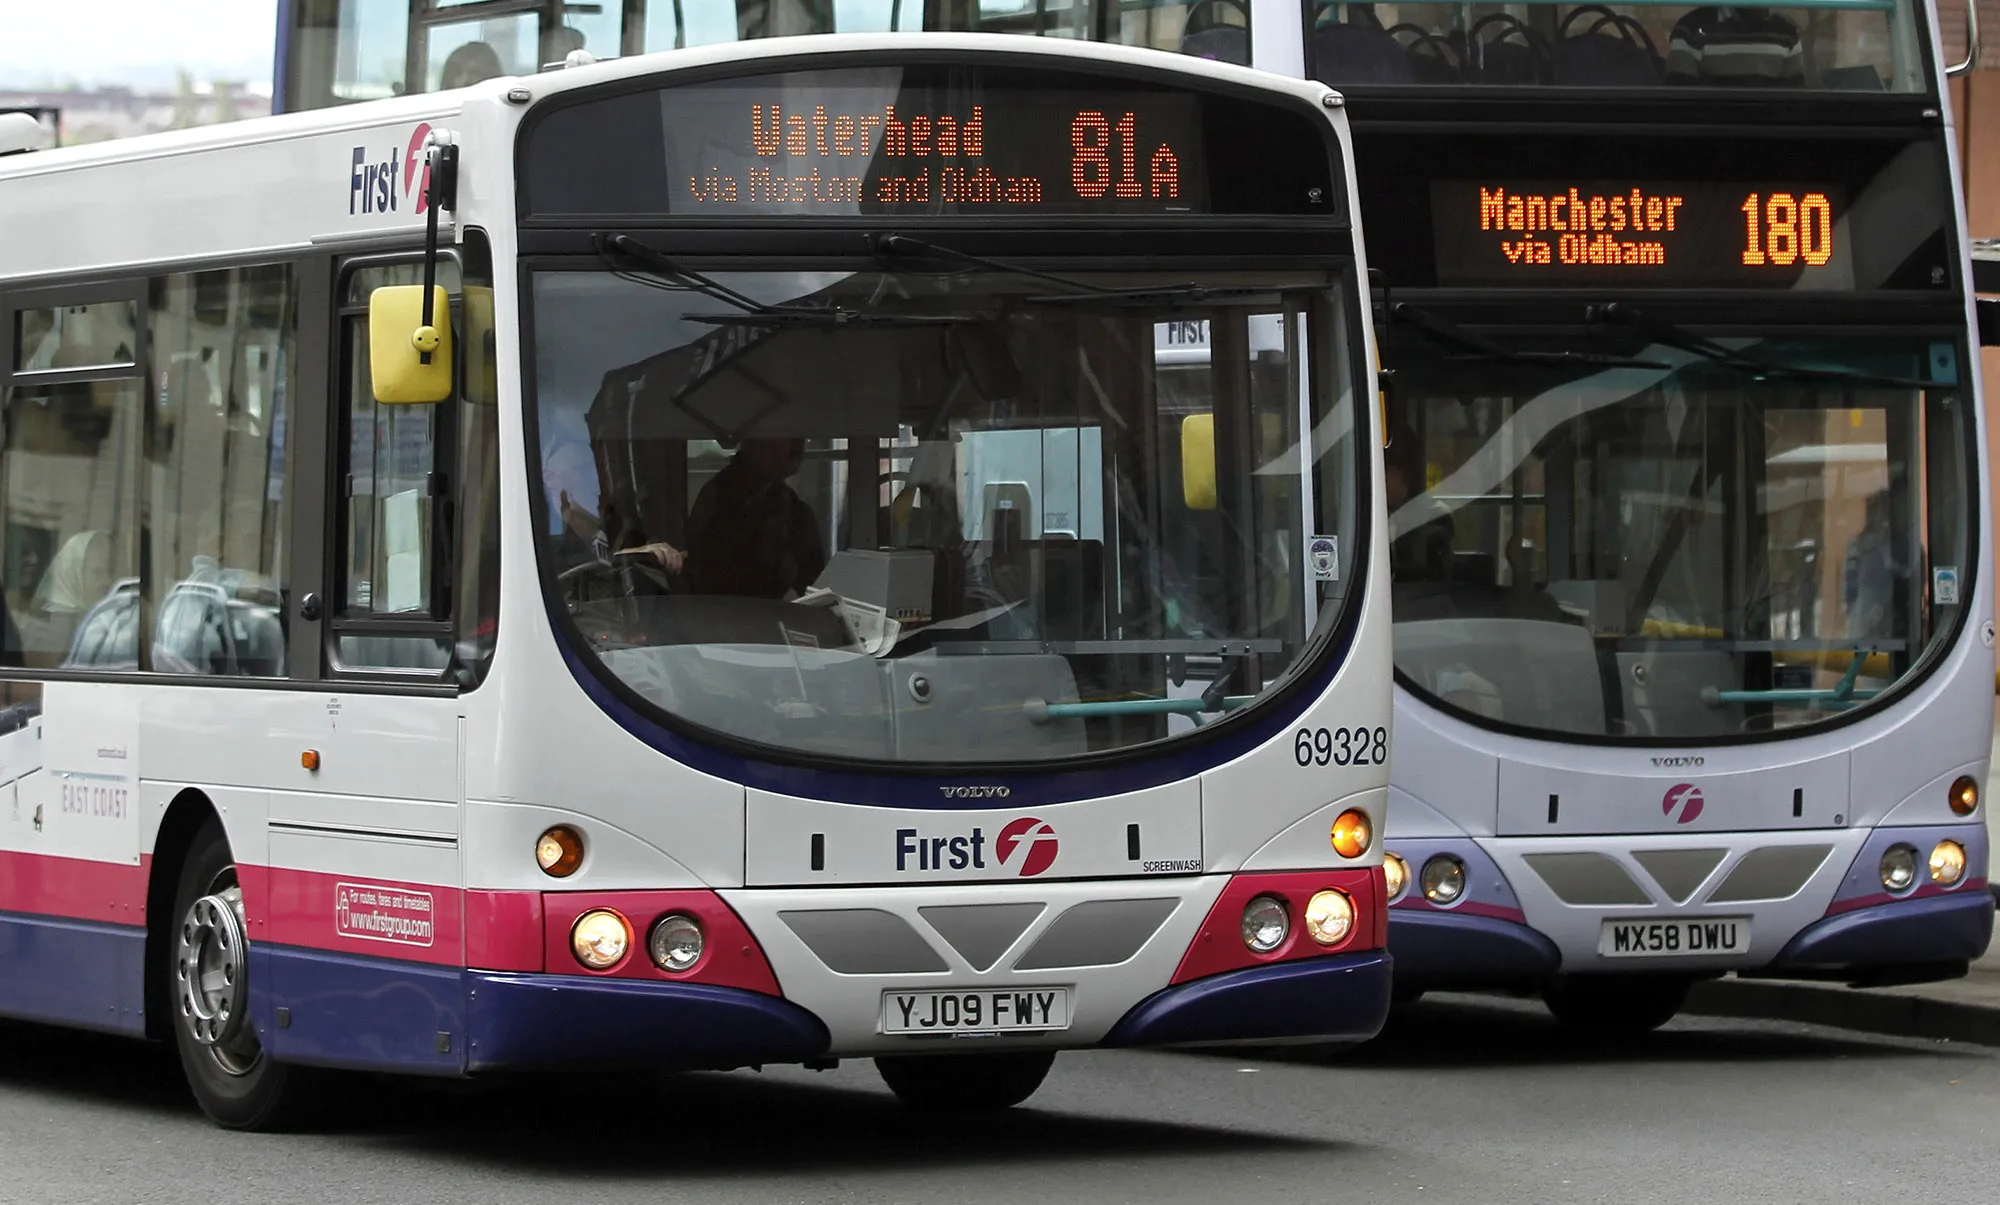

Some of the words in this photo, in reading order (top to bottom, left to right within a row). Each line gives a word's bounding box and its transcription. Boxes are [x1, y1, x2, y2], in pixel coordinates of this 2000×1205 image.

[752, 104, 984, 157] Waterhead
[350, 146, 399, 215] First
[689, 166, 738, 203] via
[749, 166, 864, 203] Moston
[876, 167, 929, 203] and
[941, 166, 1043, 203] Oldham
[1479, 187, 1683, 231] Manchester
[1740, 192, 1832, 266] 180
[1500, 233, 1552, 265] via
[1557, 233, 1665, 265] Oldham
[1294, 726, 1387, 767] 69328
[1651, 756, 1705, 767] VOLVO
[62, 784, 88, 814] EAST
[93, 787, 128, 819] COAST
[939, 785, 1011, 799] VOLVO
[896, 828, 986, 872] First
[1143, 859, 1202, 872] SCREENWASH
[350, 889, 359, 904] For
[392, 896, 403, 908] and
[350, 910, 431, 939] www.firstgroup.com
[1614, 924, 1681, 952] MX58
[1687, 923, 1737, 950] DWU
[897, 994, 982, 1028] YJ09
[992, 992, 1055, 1025] FWY
